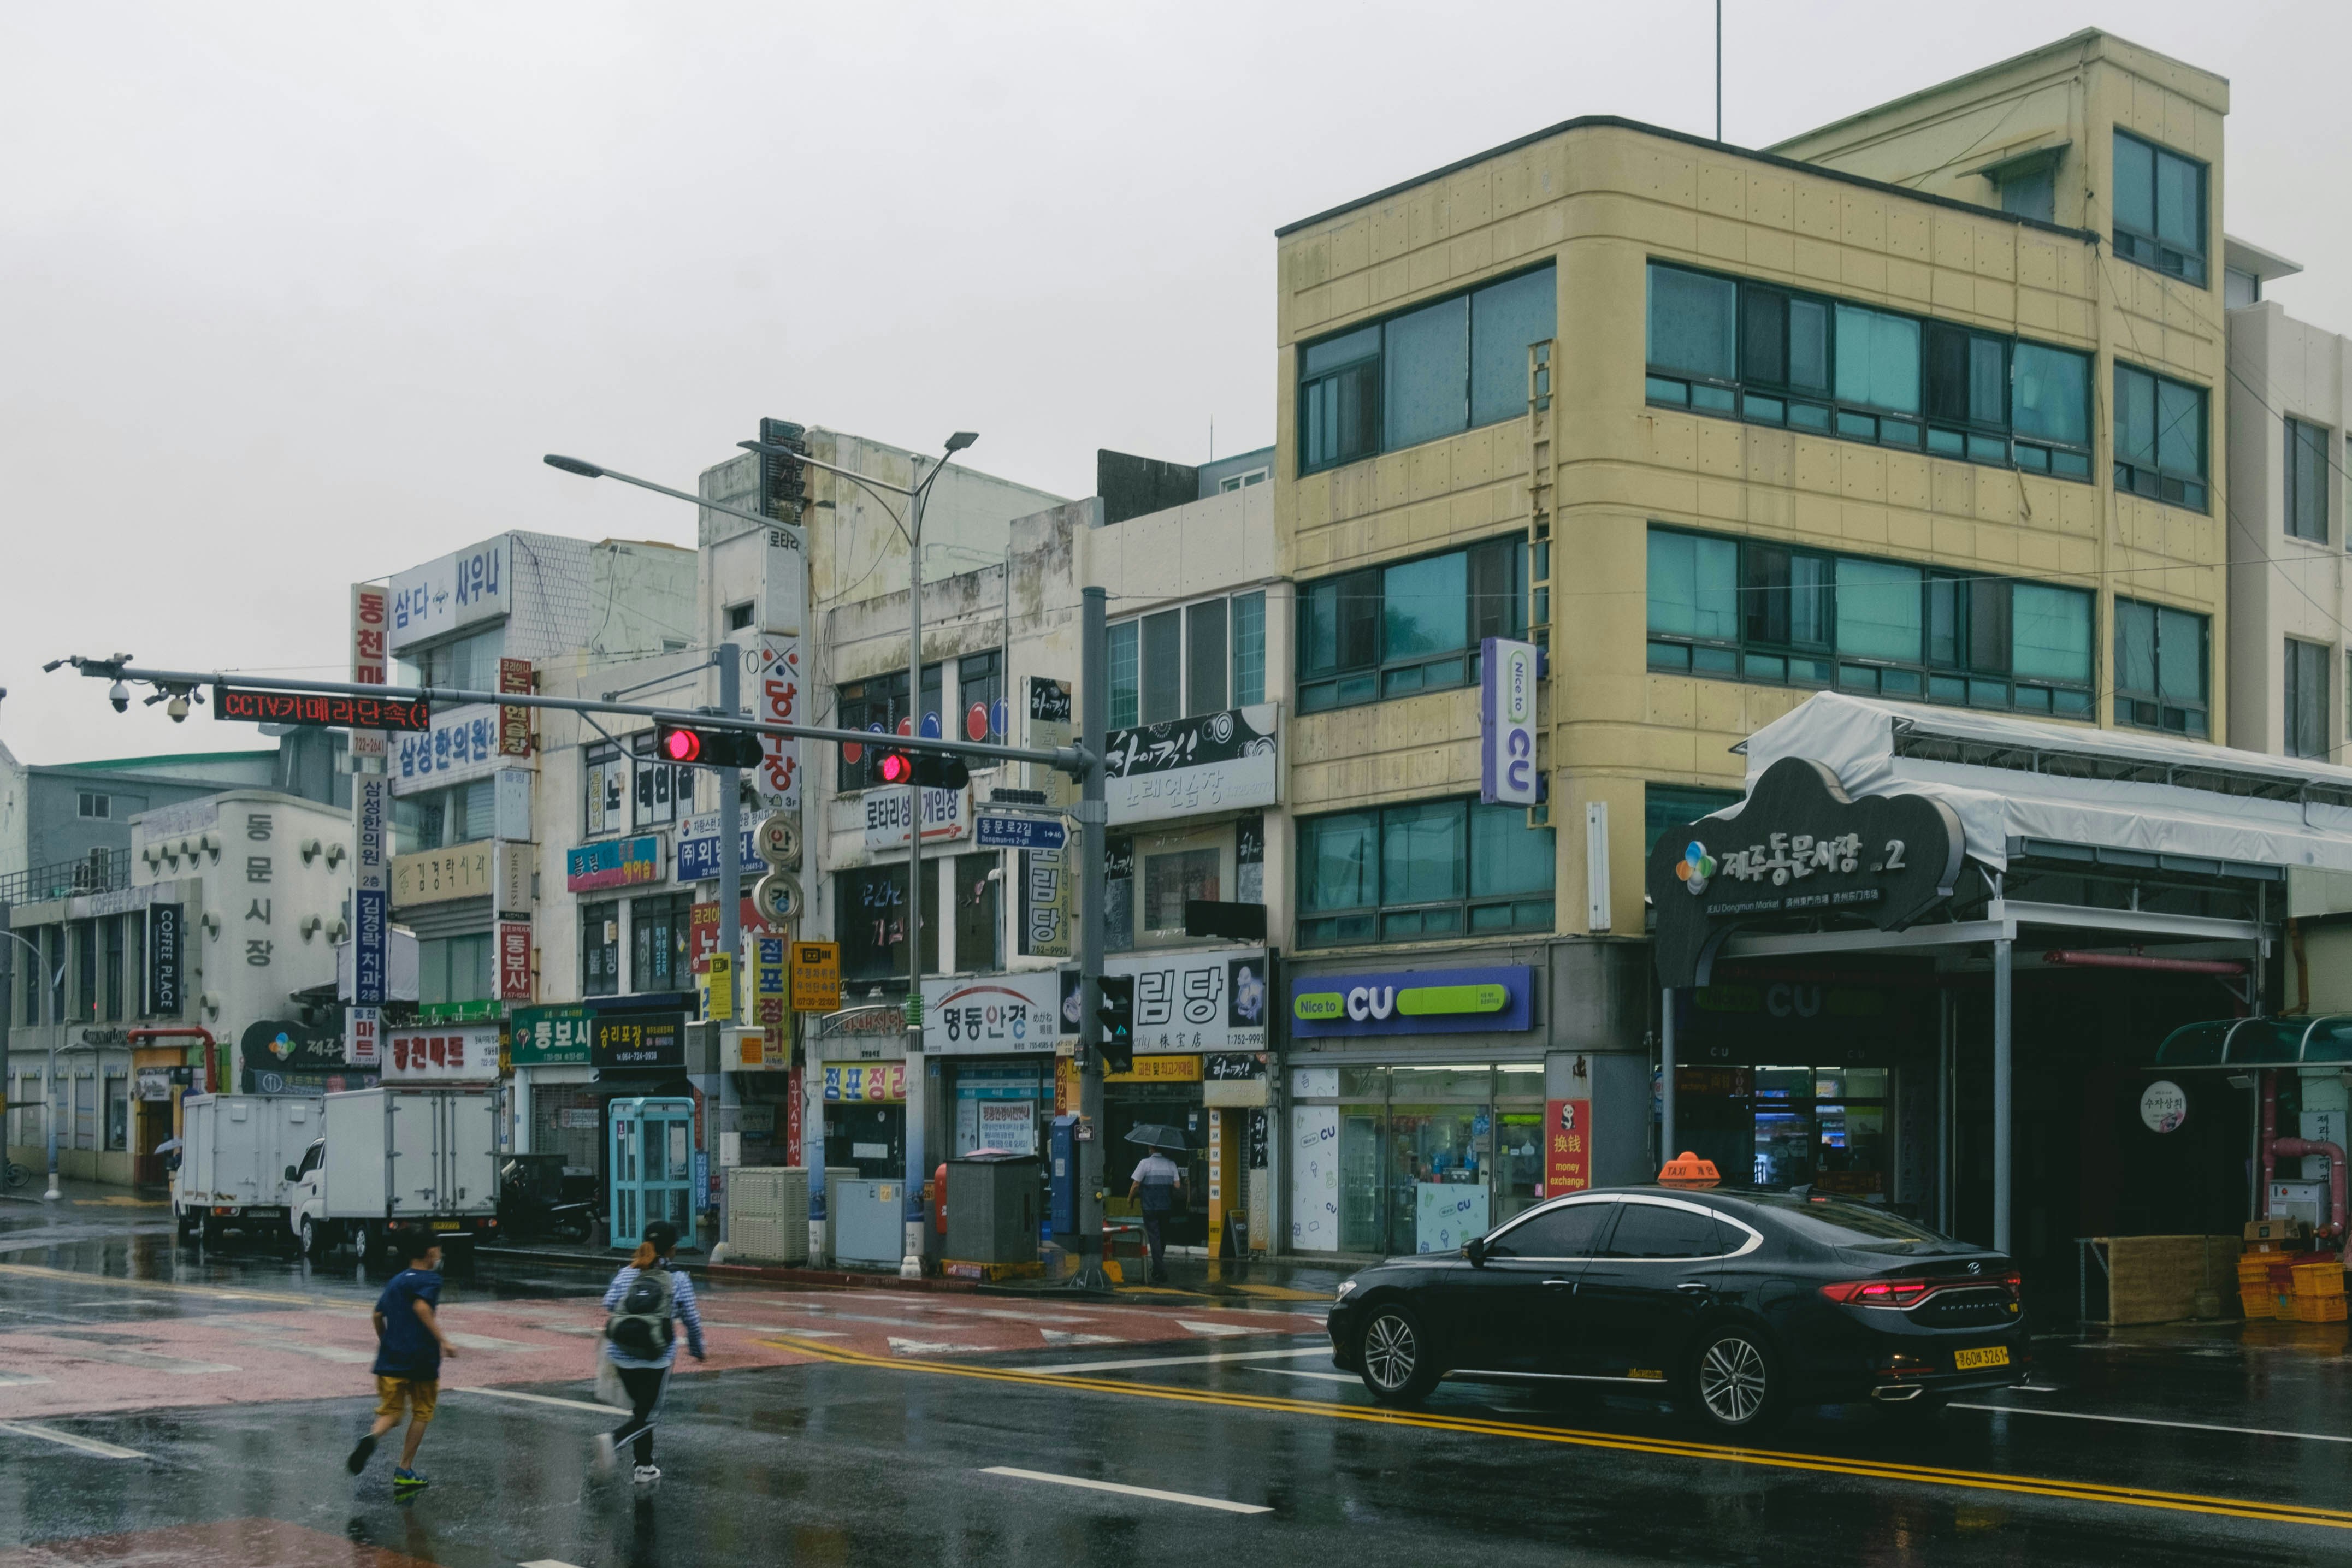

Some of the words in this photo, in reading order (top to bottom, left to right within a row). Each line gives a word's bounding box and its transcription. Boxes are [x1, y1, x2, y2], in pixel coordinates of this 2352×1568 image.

[769, 530, 799, 552] 로타리
[394, 582, 429, 629] 삼다
[456, 548, 499, 606] 사우나
[357, 593, 385, 685] 동천마
[1515, 662, 1524, 693] Nice
[1515, 695, 1524, 712] to
[400, 717, 488, 778] 삼성한의원
[1507, 728, 1530, 792] CU
[1127, 769, 1225, 809] 노래연습장
[362, 780, 382, 867] 삼성한의원
[981, 819, 1032, 837] 동문로2길
[982, 835, 1014, 845] Dongmun-ro
[1015, 836, 1029, 845] 2-gil
[682, 843, 695, 867] (주)
[1722, 832, 1861, 886] 제주동문시장
[245, 813, 275, 967] 동문시장
[362, 874, 380, 887] 2층
[511, 853, 519, 907] SHESMISS
[694, 906, 720, 925] 코리아
[1706, 904, 1721, 914] JEJU
[1722, 903, 1754, 914] Dongmun
[1755, 900, 1780, 910] Market
[161, 910, 173, 961] COFFEE
[361, 897, 382, 950] 김경락
[505, 934, 528, 990] 동보사
[1032, 945, 1067, 955] 752-9993
[361, 952, 381, 988] 치과
[796, 967, 836, 980] 주정차위반
[160, 965, 173, 1008] PLACE
[361, 989, 380, 1001] 2층
[759, 938, 784, 1054] 점포정리
[1301, 1001, 1321, 1014] Nice
[1322, 1001, 1336, 1013] to
[1347, 986, 1394, 1021] CU
[1766, 983, 1821, 1018] CU
[354, 1009, 376, 1019] 동천
[944, 1004, 1027, 1042] 명동안경
[356, 1021, 375, 1056] 마트
[600, 1025, 642, 1049] 승리포장
[1133, 1037, 1150, 1049] erly
[393, 1036, 464, 1074] 동천마트
[1161, 1061, 1194, 1076] 최고가매입
[1056, 1061, 1067, 1110] めがね
[2144, 1098, 2183, 1110] 수자상회
[1320, 1126, 1335, 1141] CU
[1553, 1134, 1582, 1154] 换钱
[1555, 1162, 1580, 1174] money
[1667, 1165, 1687, 1177] TAXI
[1550, 1176, 1585, 1188] exchange
[1326, 1202, 1338, 1214] CU
[1457, 1199, 1471, 1212] CU
[1983, 1349, 2006, 1365] 3261
